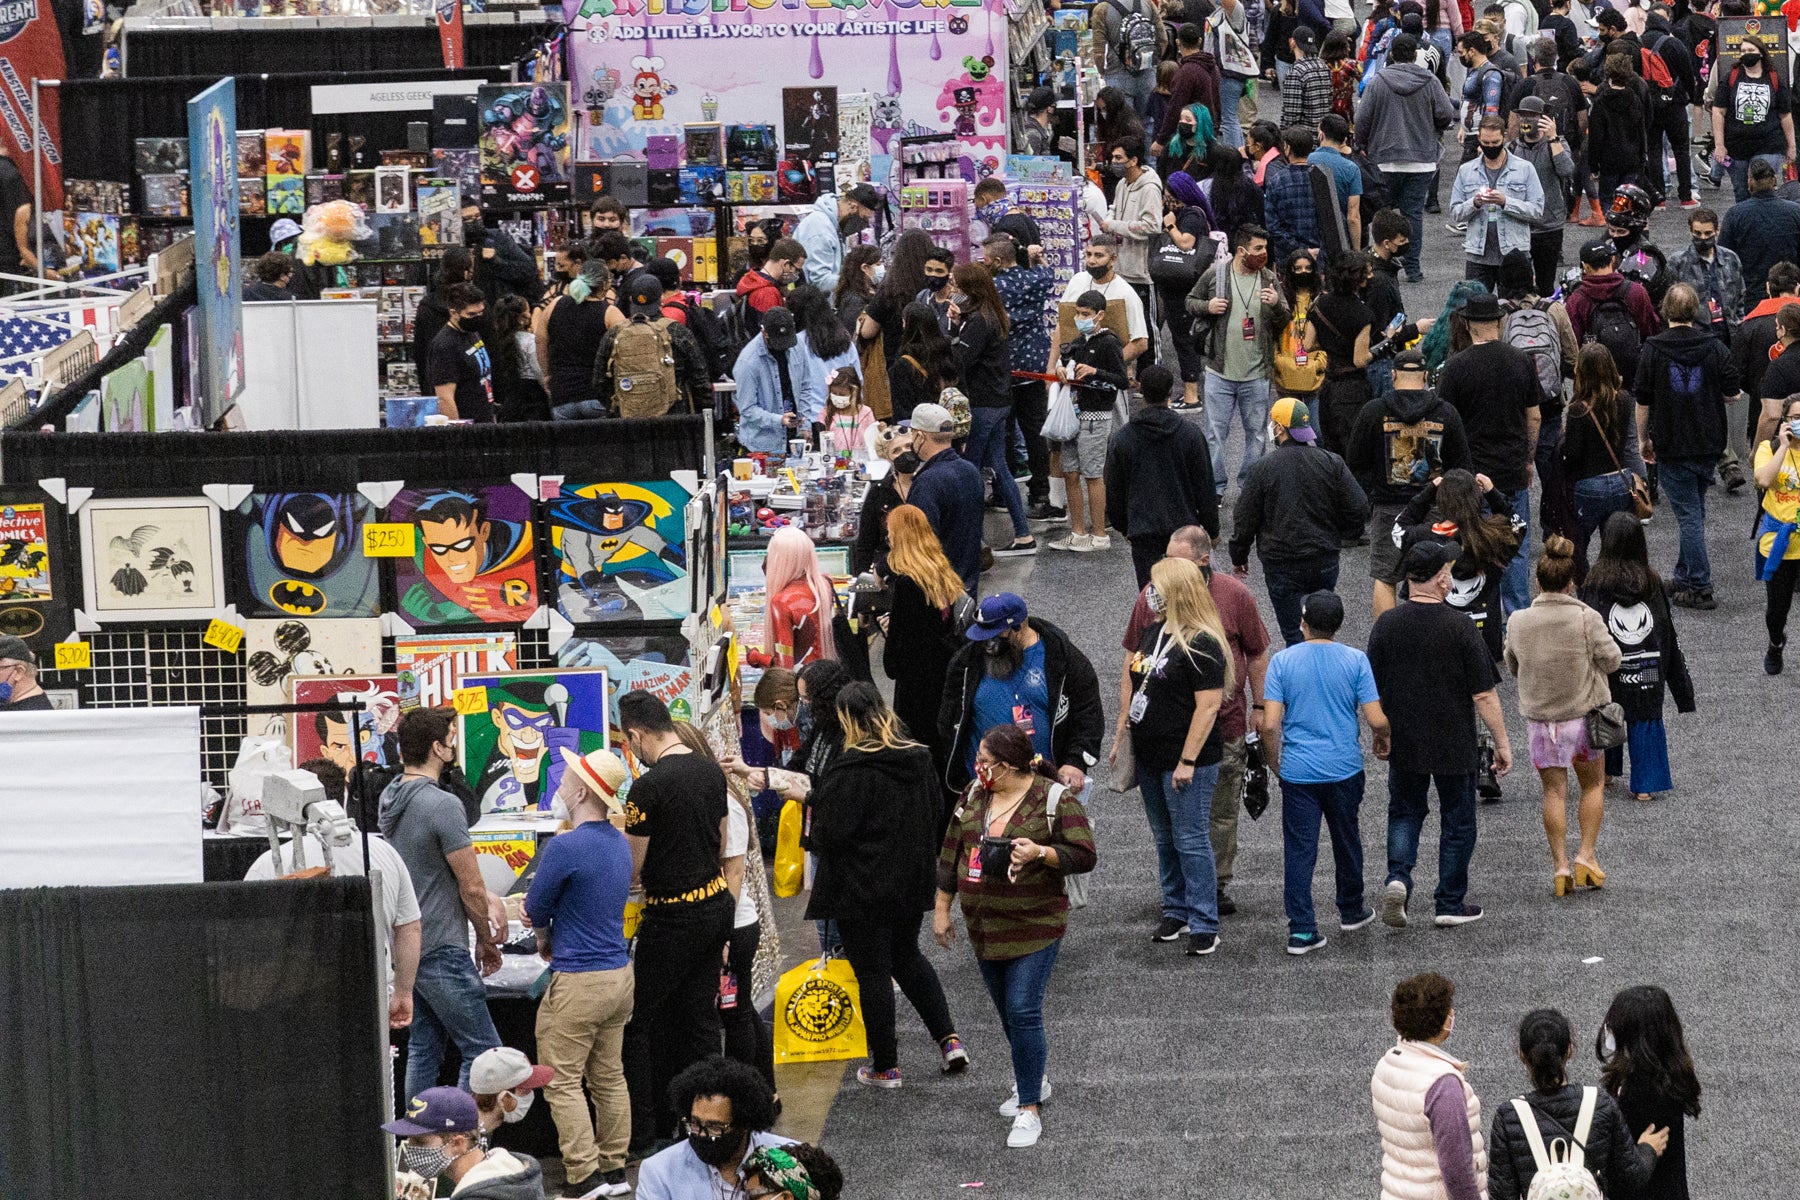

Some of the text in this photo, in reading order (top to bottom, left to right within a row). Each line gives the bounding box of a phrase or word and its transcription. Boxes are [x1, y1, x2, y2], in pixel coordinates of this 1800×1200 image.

[612, 18, 945, 39] ADD LITTLE FLAVOR TO YOUR ARTISTIC LIFE
[370, 91, 432, 102] AGELESS GEEKS
[366, 527, 405, 552] $250
[209, 623, 242, 650] $400
[57, 646, 89, 665] $200
[420, 633, 517, 709] HULK
[630, 672, 671, 692] AMAZING
[456, 689, 485, 713] $175
